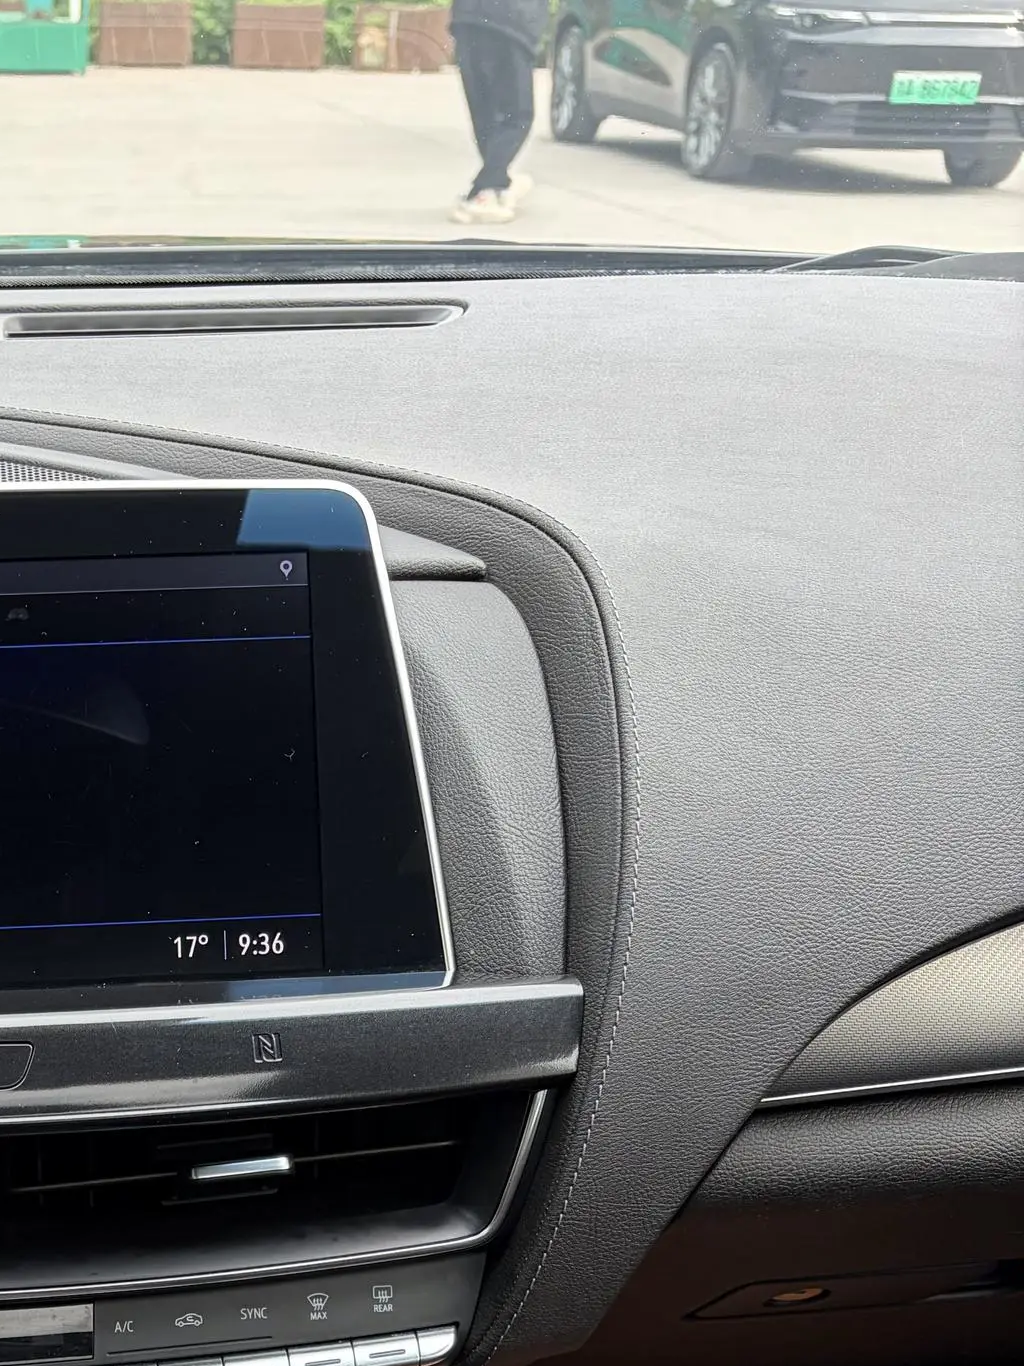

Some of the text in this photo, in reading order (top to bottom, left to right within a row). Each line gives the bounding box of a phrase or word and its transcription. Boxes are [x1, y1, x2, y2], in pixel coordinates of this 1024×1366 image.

[173, 934, 209, 959] 17°
[238, 932, 285, 956] 9:36
[240, 1307, 268, 1320] SYNC
[373, 1303, 394, 1313] REAR
[310, 1311, 328, 1321] MAX
[114, 1320, 134, 1333] A/C
